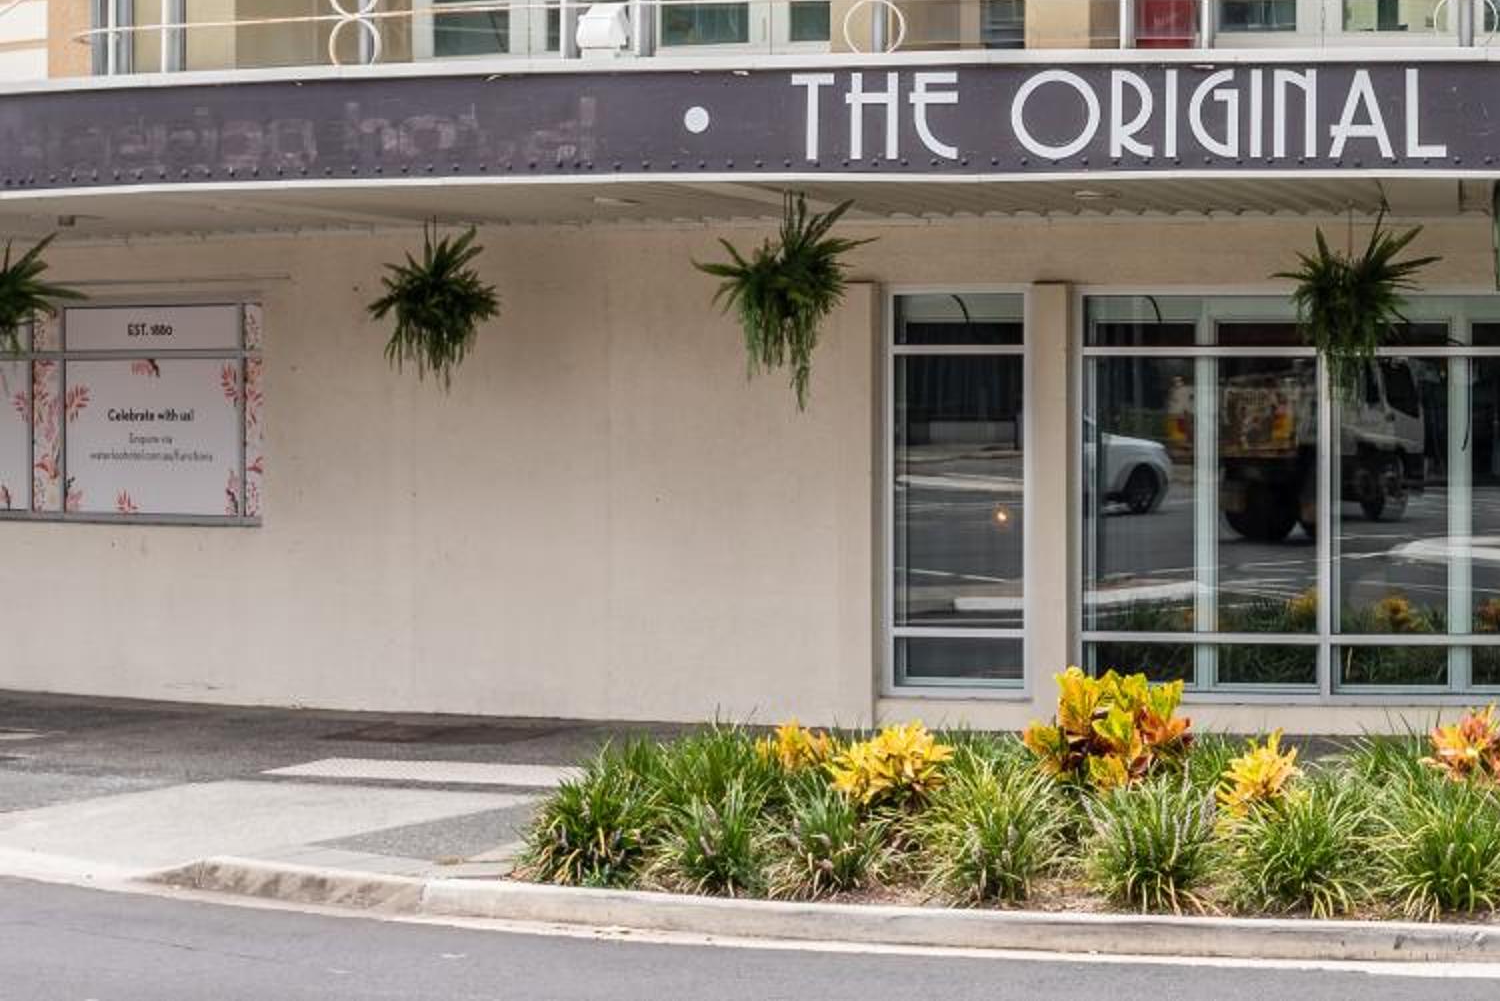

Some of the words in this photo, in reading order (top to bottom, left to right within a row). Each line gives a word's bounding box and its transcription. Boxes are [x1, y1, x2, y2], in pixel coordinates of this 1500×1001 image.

[791, 71, 959, 161] THE
[1010, 68, 1448, 160] ORIGINAL
[127, 323, 149, 337] EST.
[107, 408, 155, 422] Celebrate
[157, 408, 178, 421] with
